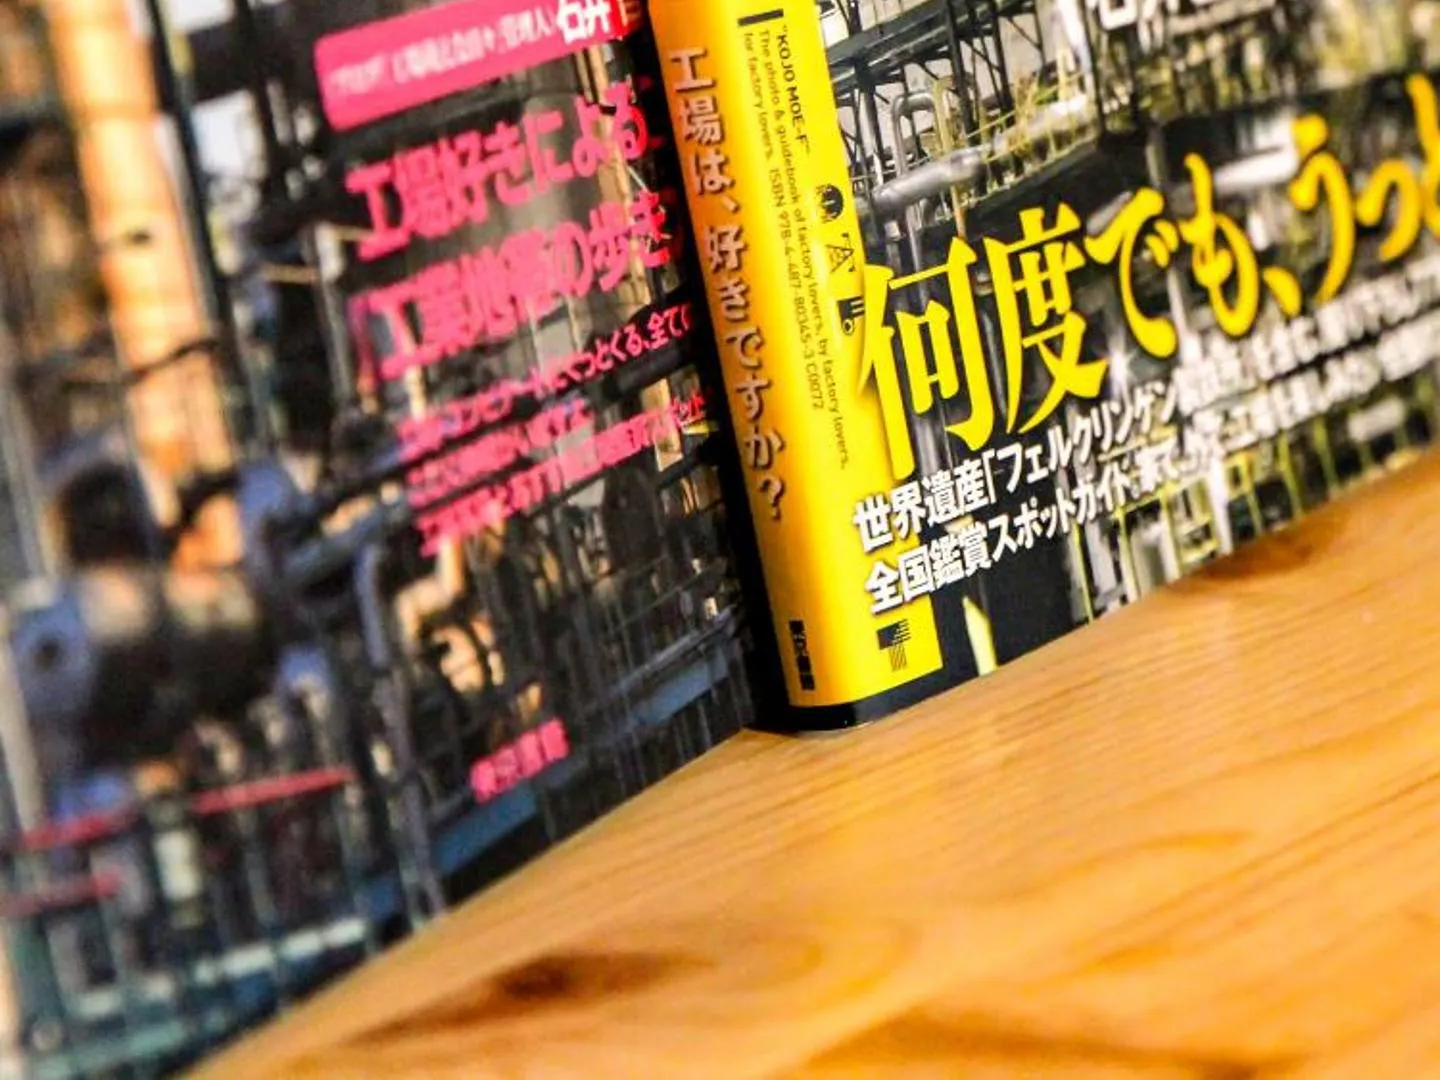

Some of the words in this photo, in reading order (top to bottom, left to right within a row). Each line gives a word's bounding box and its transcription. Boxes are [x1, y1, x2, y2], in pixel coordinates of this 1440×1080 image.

[743, 31, 756, 55] for
[758, 29, 772, 60] The
[747, 54, 765, 110] factory
[765, 61, 782, 107] photo
[767, 167, 786, 209] ISBN
[776, 124, 802, 207] guidebook
[799, 224, 816, 279] factory
[817, 338, 829, 356] by
[822, 358, 840, 413] factory
